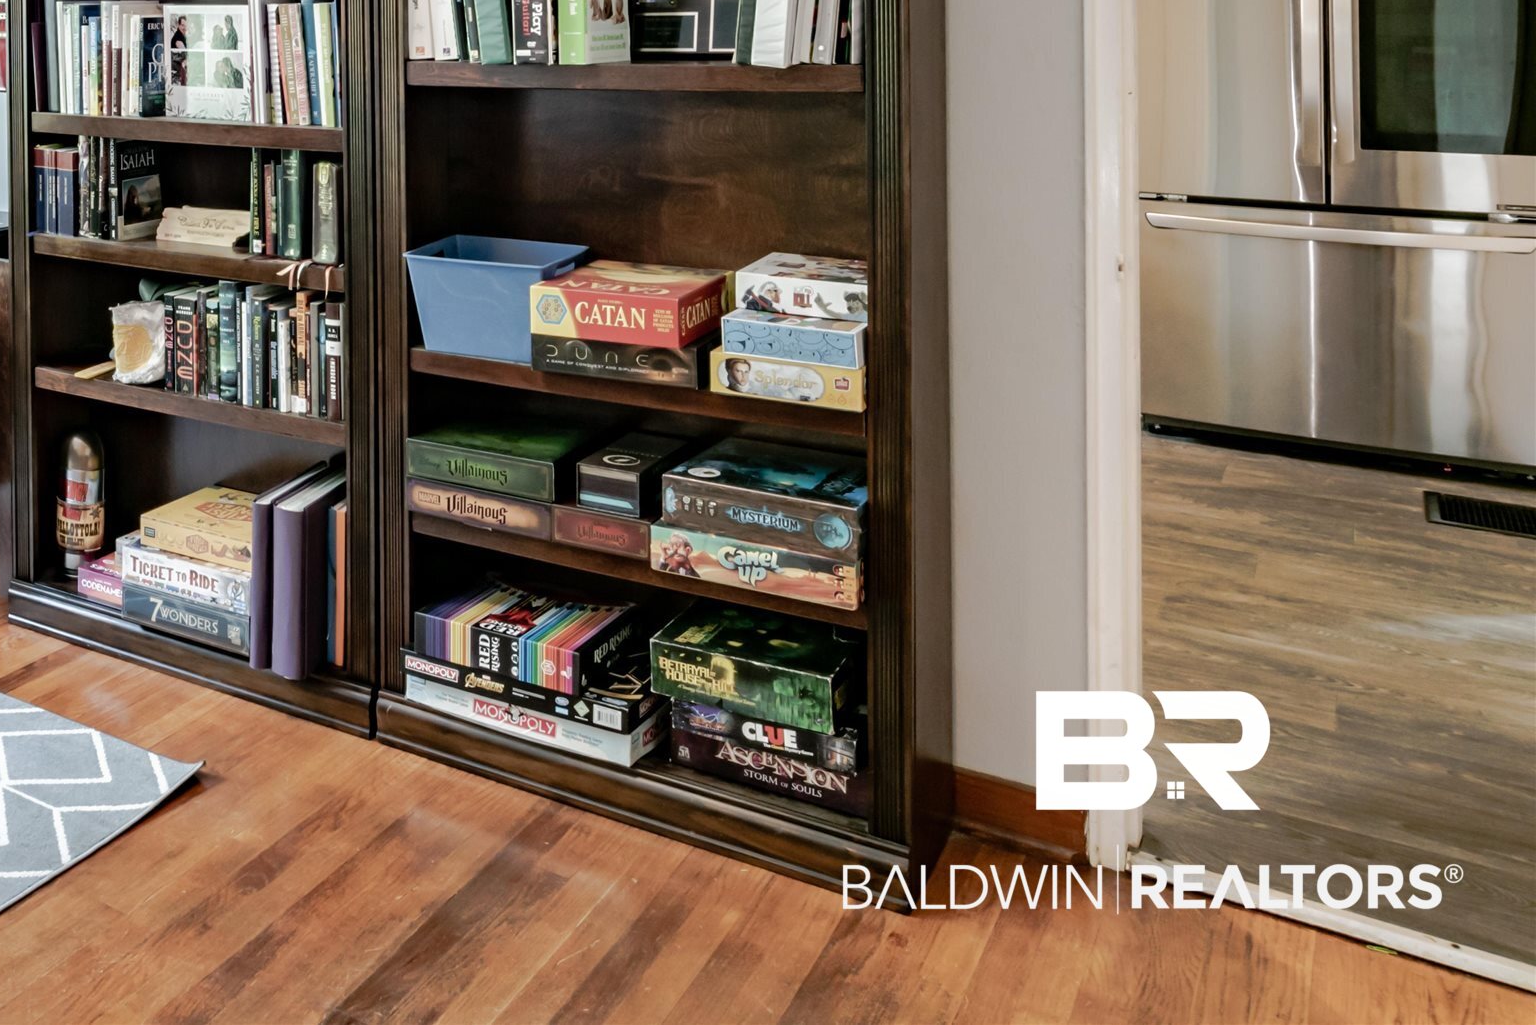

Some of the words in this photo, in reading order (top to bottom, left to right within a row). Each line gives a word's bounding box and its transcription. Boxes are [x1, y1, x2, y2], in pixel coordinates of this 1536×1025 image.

[147, 22, 160, 30] ERIC
[530, 2, 543, 36] Play
[120, 149, 155, 171] ISAIAH
[574, 301, 647, 330] CATAN
[686, 298, 711, 329] CATAN
[253, 316, 261, 340] Reborn
[177, 320, 193, 380] DUNE
[546, 341, 650, 368] DUNE
[575, 361, 604, 369] CONQUEST
[754, 368, 817, 390] Splendor
[446, 459, 508, 486] Villainous
[418, 492, 441, 505] MARVEL
[445, 494, 508, 525] Villainous
[731, 506, 800, 532] MYSTERIUM
[577, 525, 626, 546] Villainous
[130, 555, 174, 582] TICKET
[176, 571, 187, 582] TO
[189, 569, 219, 593] RIDE
[81, 579, 122, 597] CODENAME
[149, 597, 163, 622] 7
[160, 607, 219, 633] WONDERS
[479, 634, 491, 669] RED
[491, 637, 501, 672] RISING
[594, 642, 609, 663] RED
[609, 625, 632, 651] RISING
[407, 660, 457, 680] MONOPOLY
[658, 656, 712, 677] BETRAYAL
[465, 673, 505, 693] AVENGERS
[666, 669, 701, 686] HOUSE
[712, 678, 735, 693] HILL
[475, 701, 555, 735] MONOPOLY
[742, 722, 798, 749] CLUE
[715, 740, 850, 794] ASCENSION
[743, 769, 778, 786] STORM
[791, 782, 823, 798] SOULS
